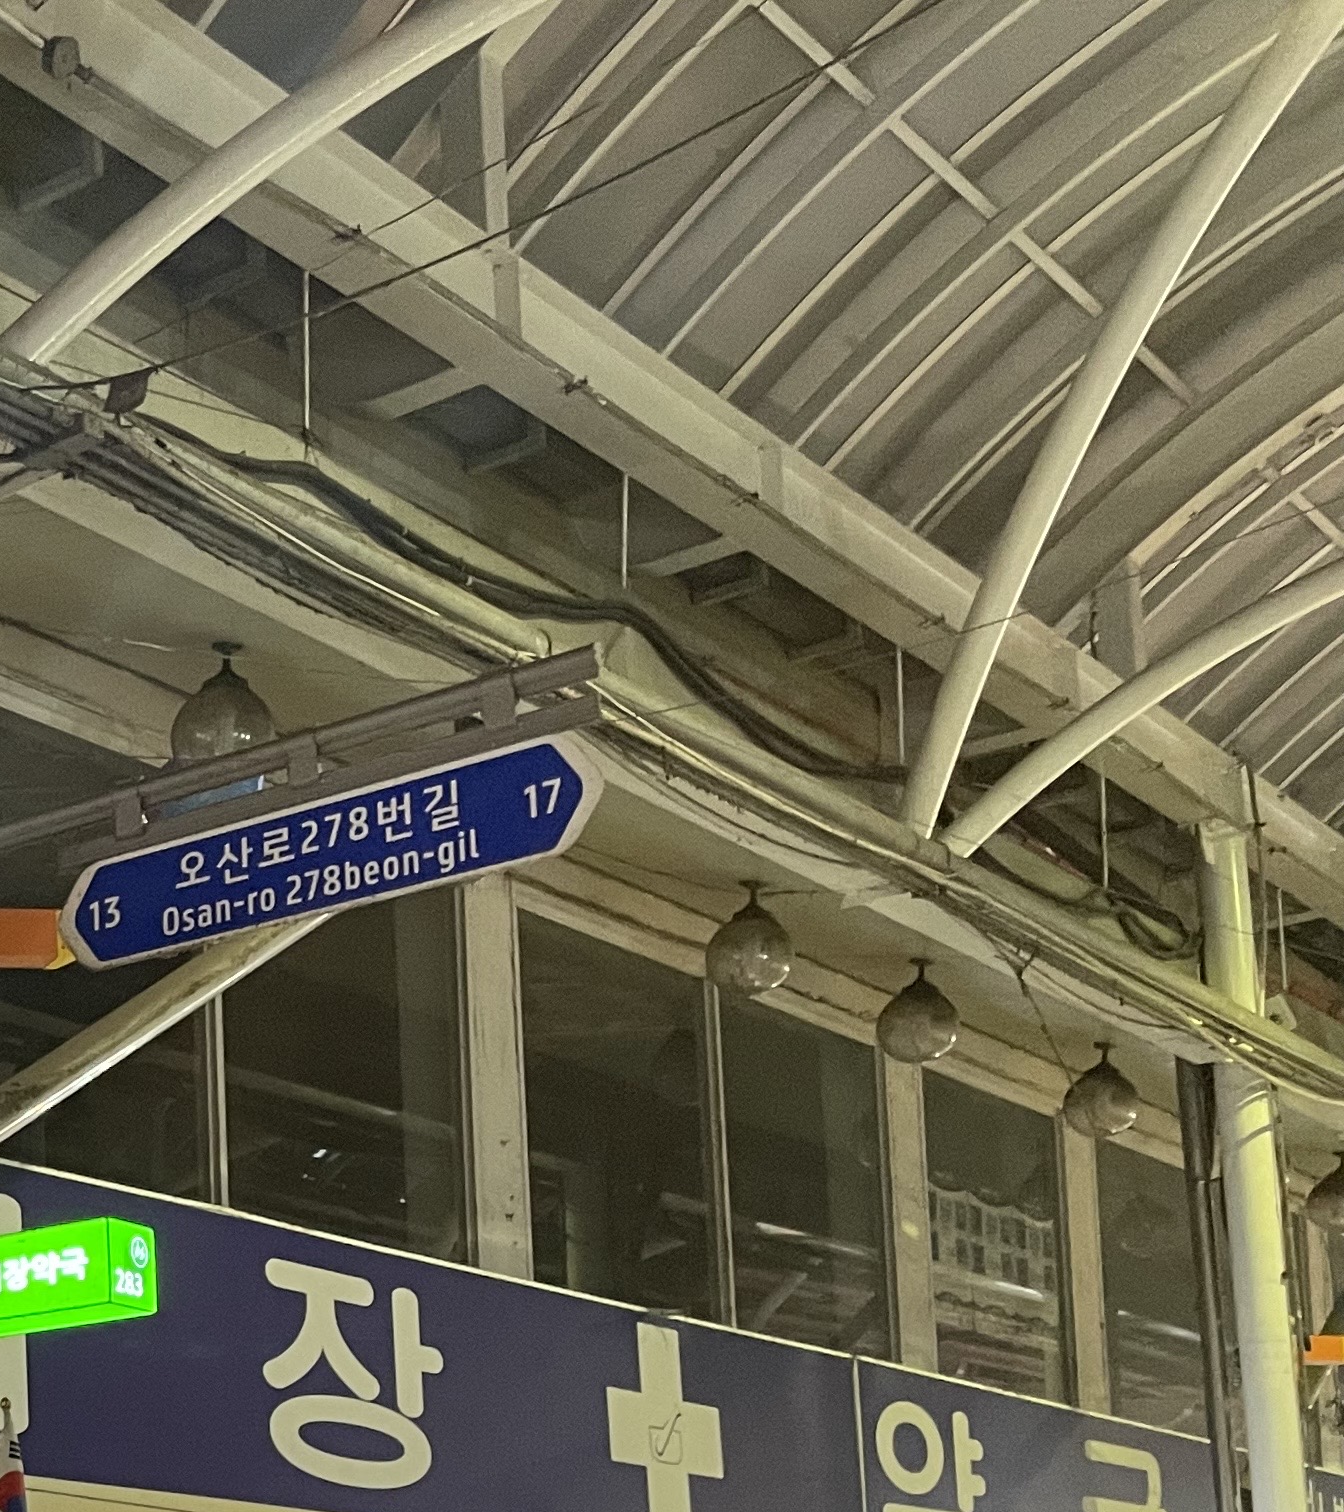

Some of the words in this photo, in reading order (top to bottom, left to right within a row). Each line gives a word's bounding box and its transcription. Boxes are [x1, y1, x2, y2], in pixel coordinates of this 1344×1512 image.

[522, 777, 564, 818] 17
[174, 778, 462, 889] 오산로278번길
[162, 886, 276, 937] Osan-ro
[285, 828, 480, 906] 278beon-gil
[88, 898, 122, 932] 13
[113, 1267, 144, 1298] 283
